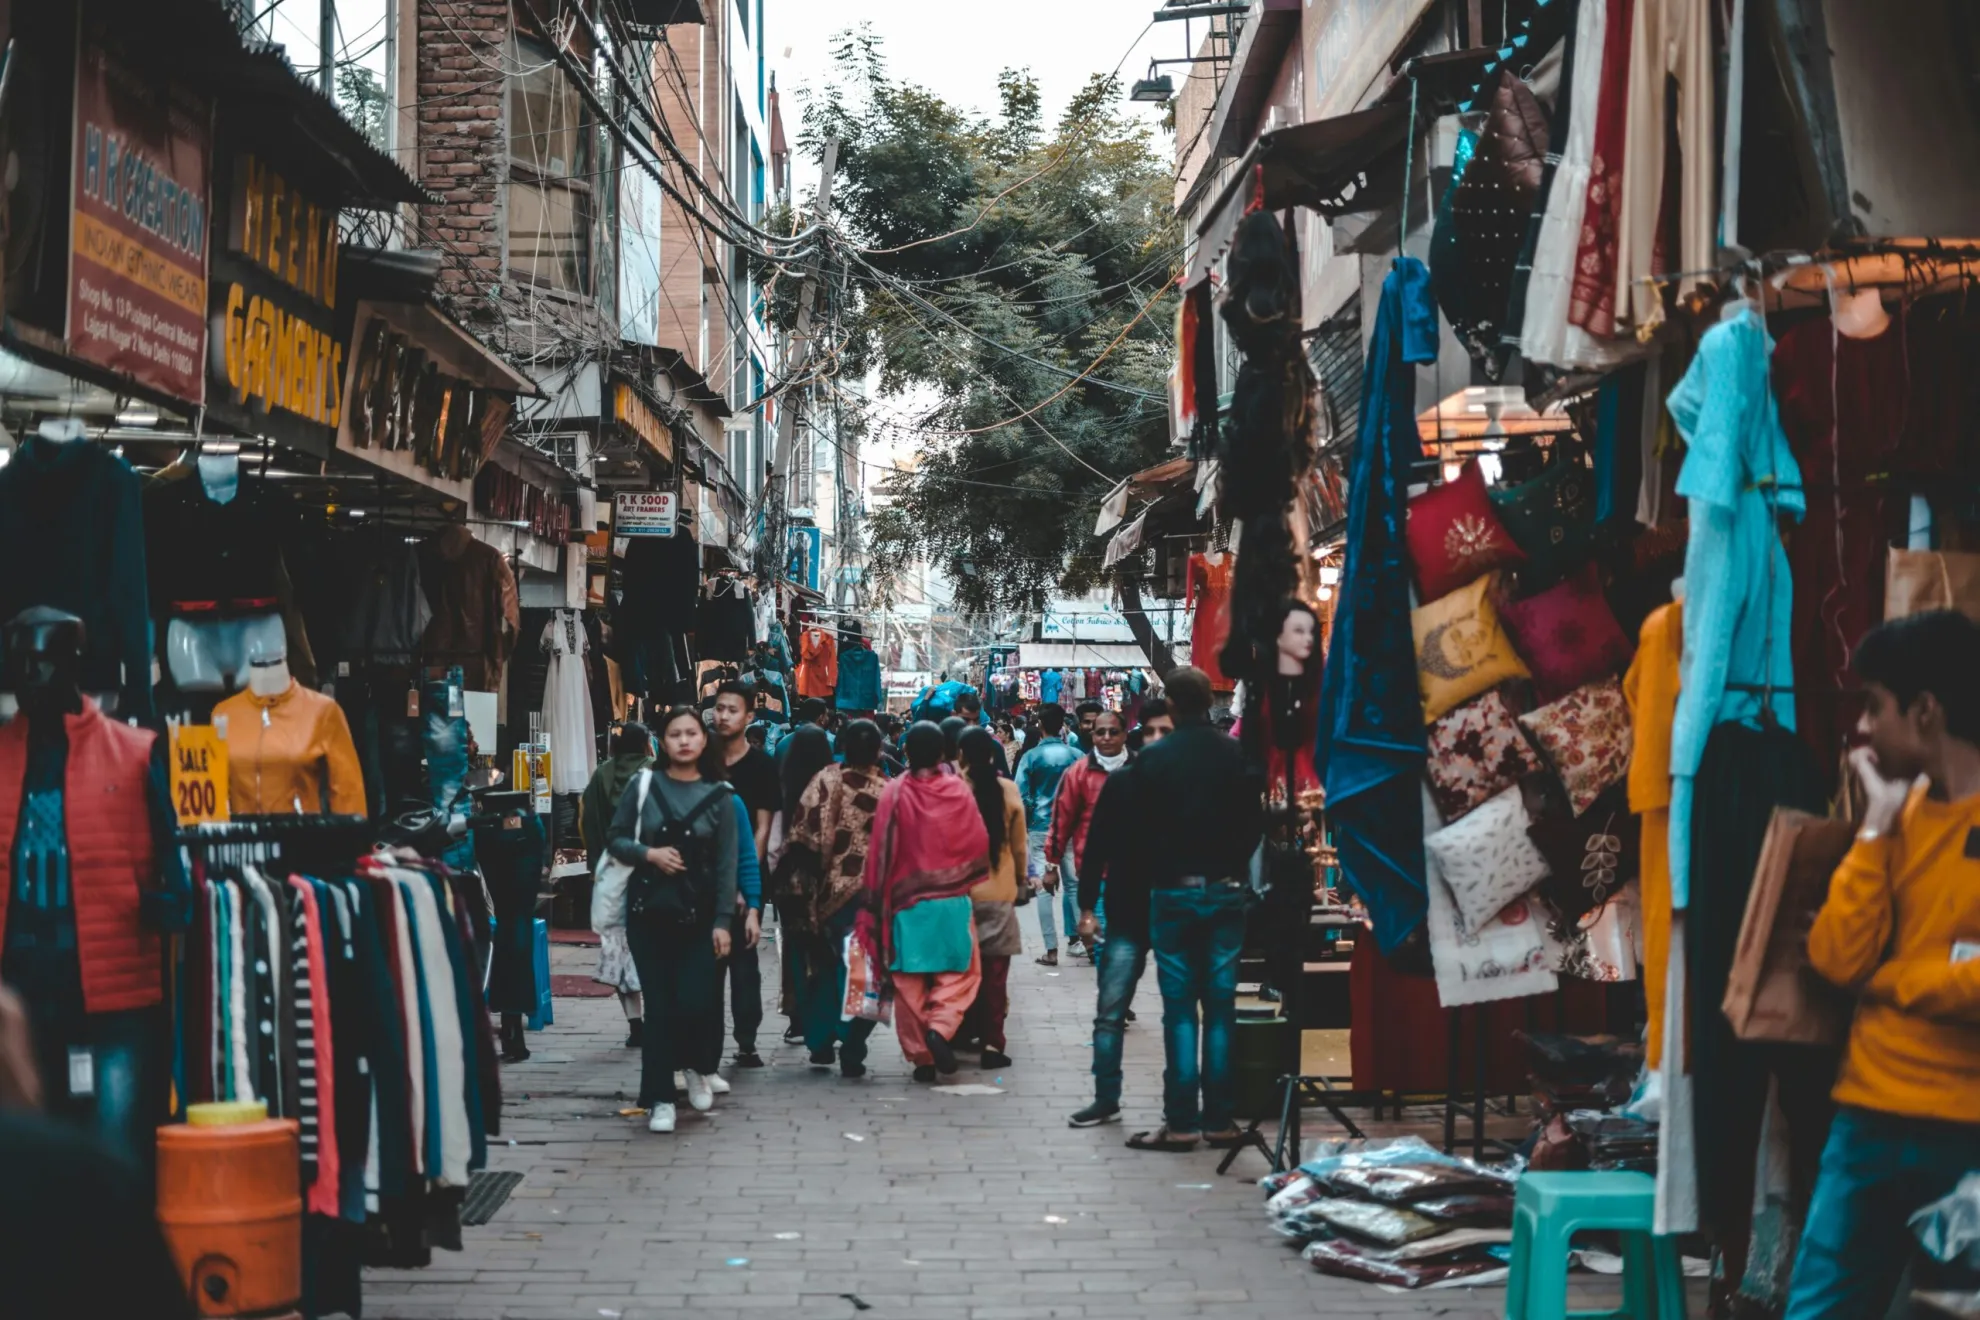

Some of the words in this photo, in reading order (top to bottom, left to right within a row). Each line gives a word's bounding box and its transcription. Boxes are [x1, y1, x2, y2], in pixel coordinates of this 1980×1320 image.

[121, 147, 205, 261] CREATION
[243, 155, 338, 310] MEENU
[168, 273, 201, 307] WEAR
[79, 278, 100, 310] Shop
[116, 296, 125, 318] 13
[153, 313, 176, 342] Central
[177, 325, 198, 353] Market
[138, 335, 153, 358] New
[153, 341, 171, 366] Delhi
[225, 282, 341, 428] GARMENTS
[619, 495, 628, 505] R
[630, 495, 638, 505] K
[641, 495, 669, 505] SOOD
[178, 747, 208, 772] SALE
[178, 780, 216, 817] 200
